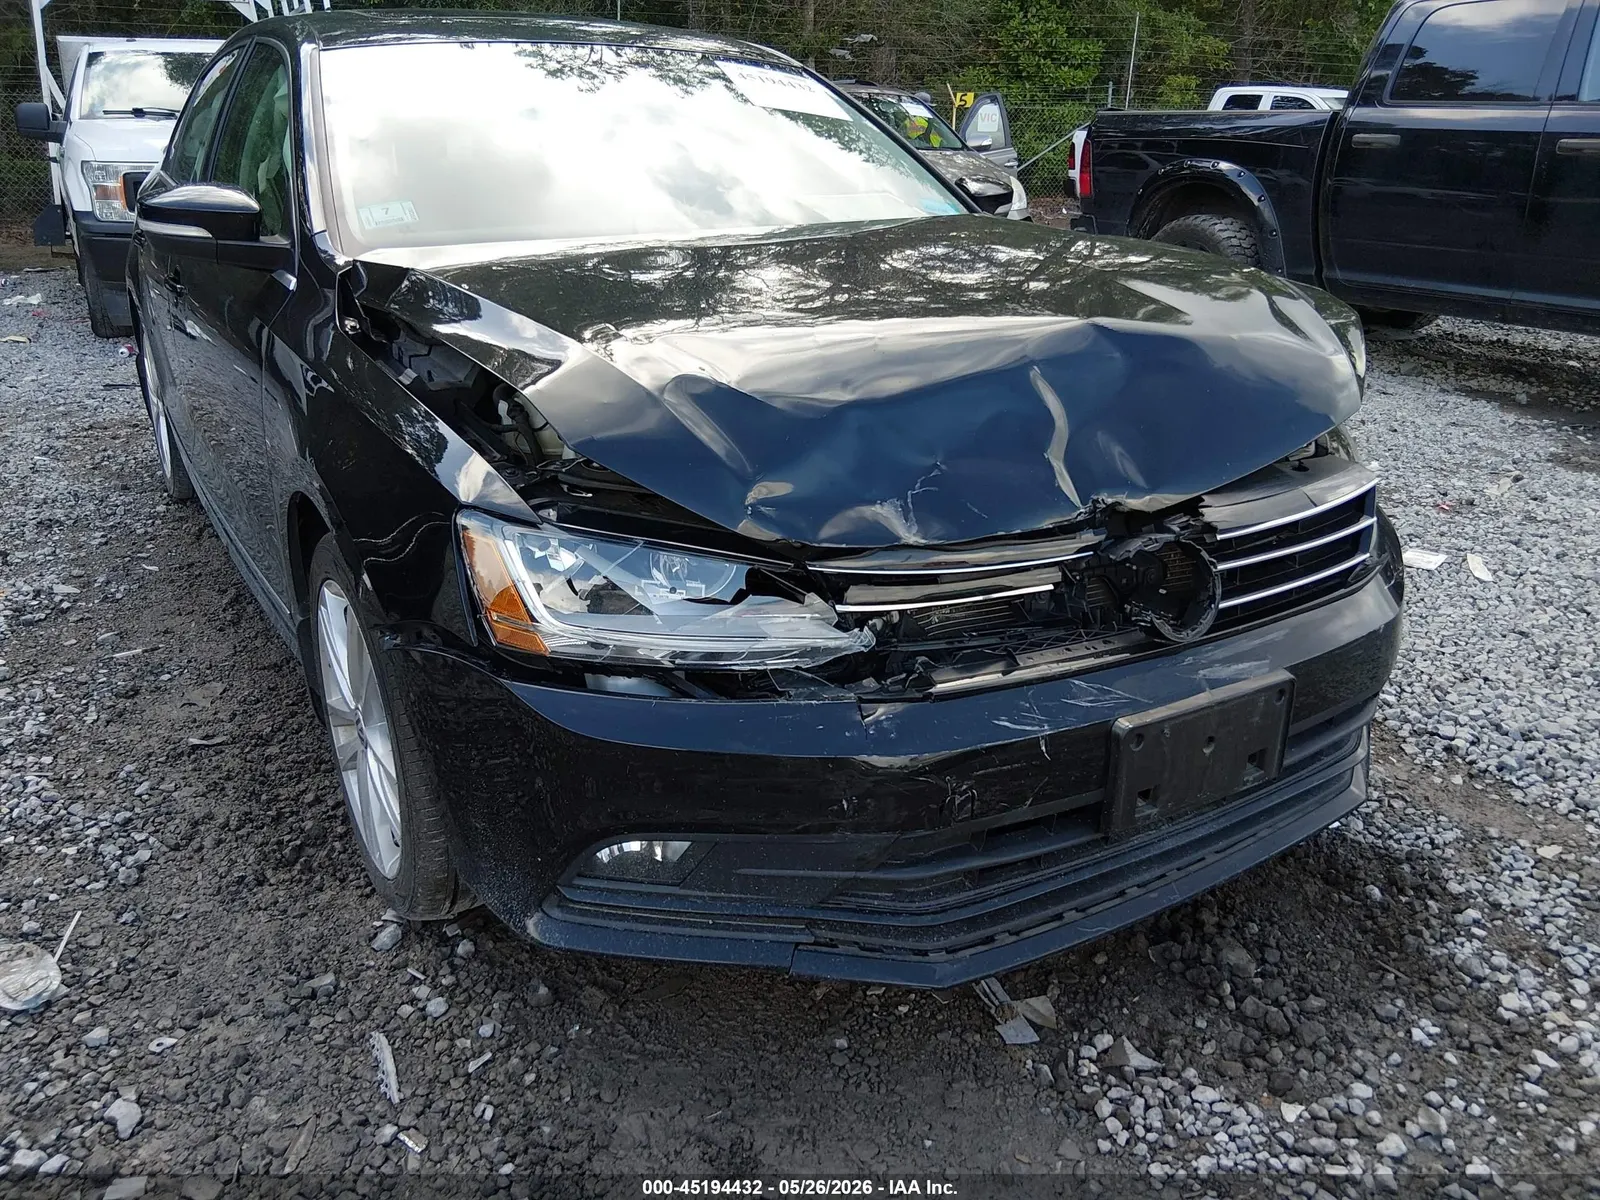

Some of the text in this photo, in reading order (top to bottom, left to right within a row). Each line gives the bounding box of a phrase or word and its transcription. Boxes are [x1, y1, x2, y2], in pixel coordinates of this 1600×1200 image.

[957, 93, 968, 107] 5
[980, 113, 998, 123] VIC
[381, 207, 390, 216] 7
